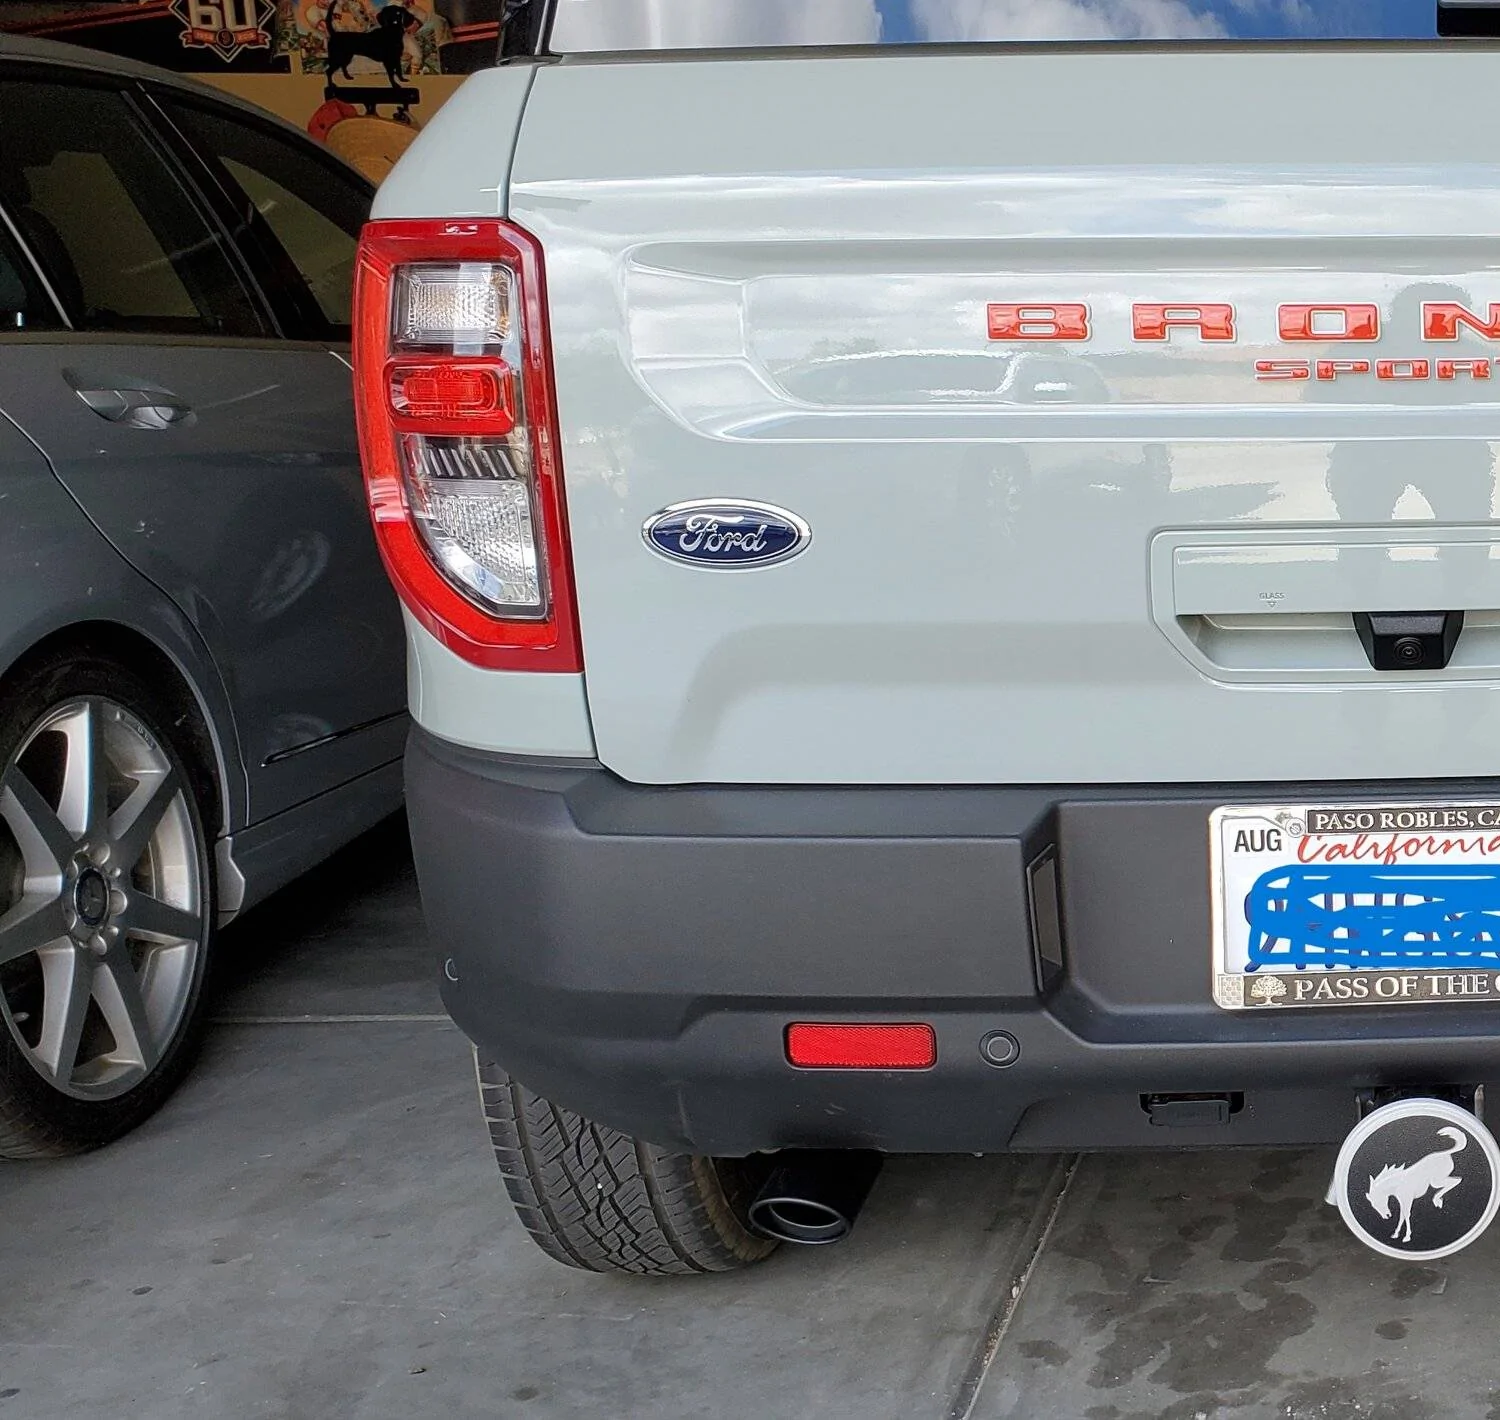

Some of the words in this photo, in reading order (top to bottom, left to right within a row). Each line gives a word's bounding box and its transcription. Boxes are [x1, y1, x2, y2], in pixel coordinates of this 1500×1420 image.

[679, 512, 769, 552] Ford
[1259, 592, 1285, 600] GLASS
[1315, 811, 1375, 831] PASO
[1234, 828, 1283, 853] AUG
[1293, 976, 1369, 1001] PASS
[1374, 974, 1419, 998] OF
[1422, 972, 1490, 997] THE
